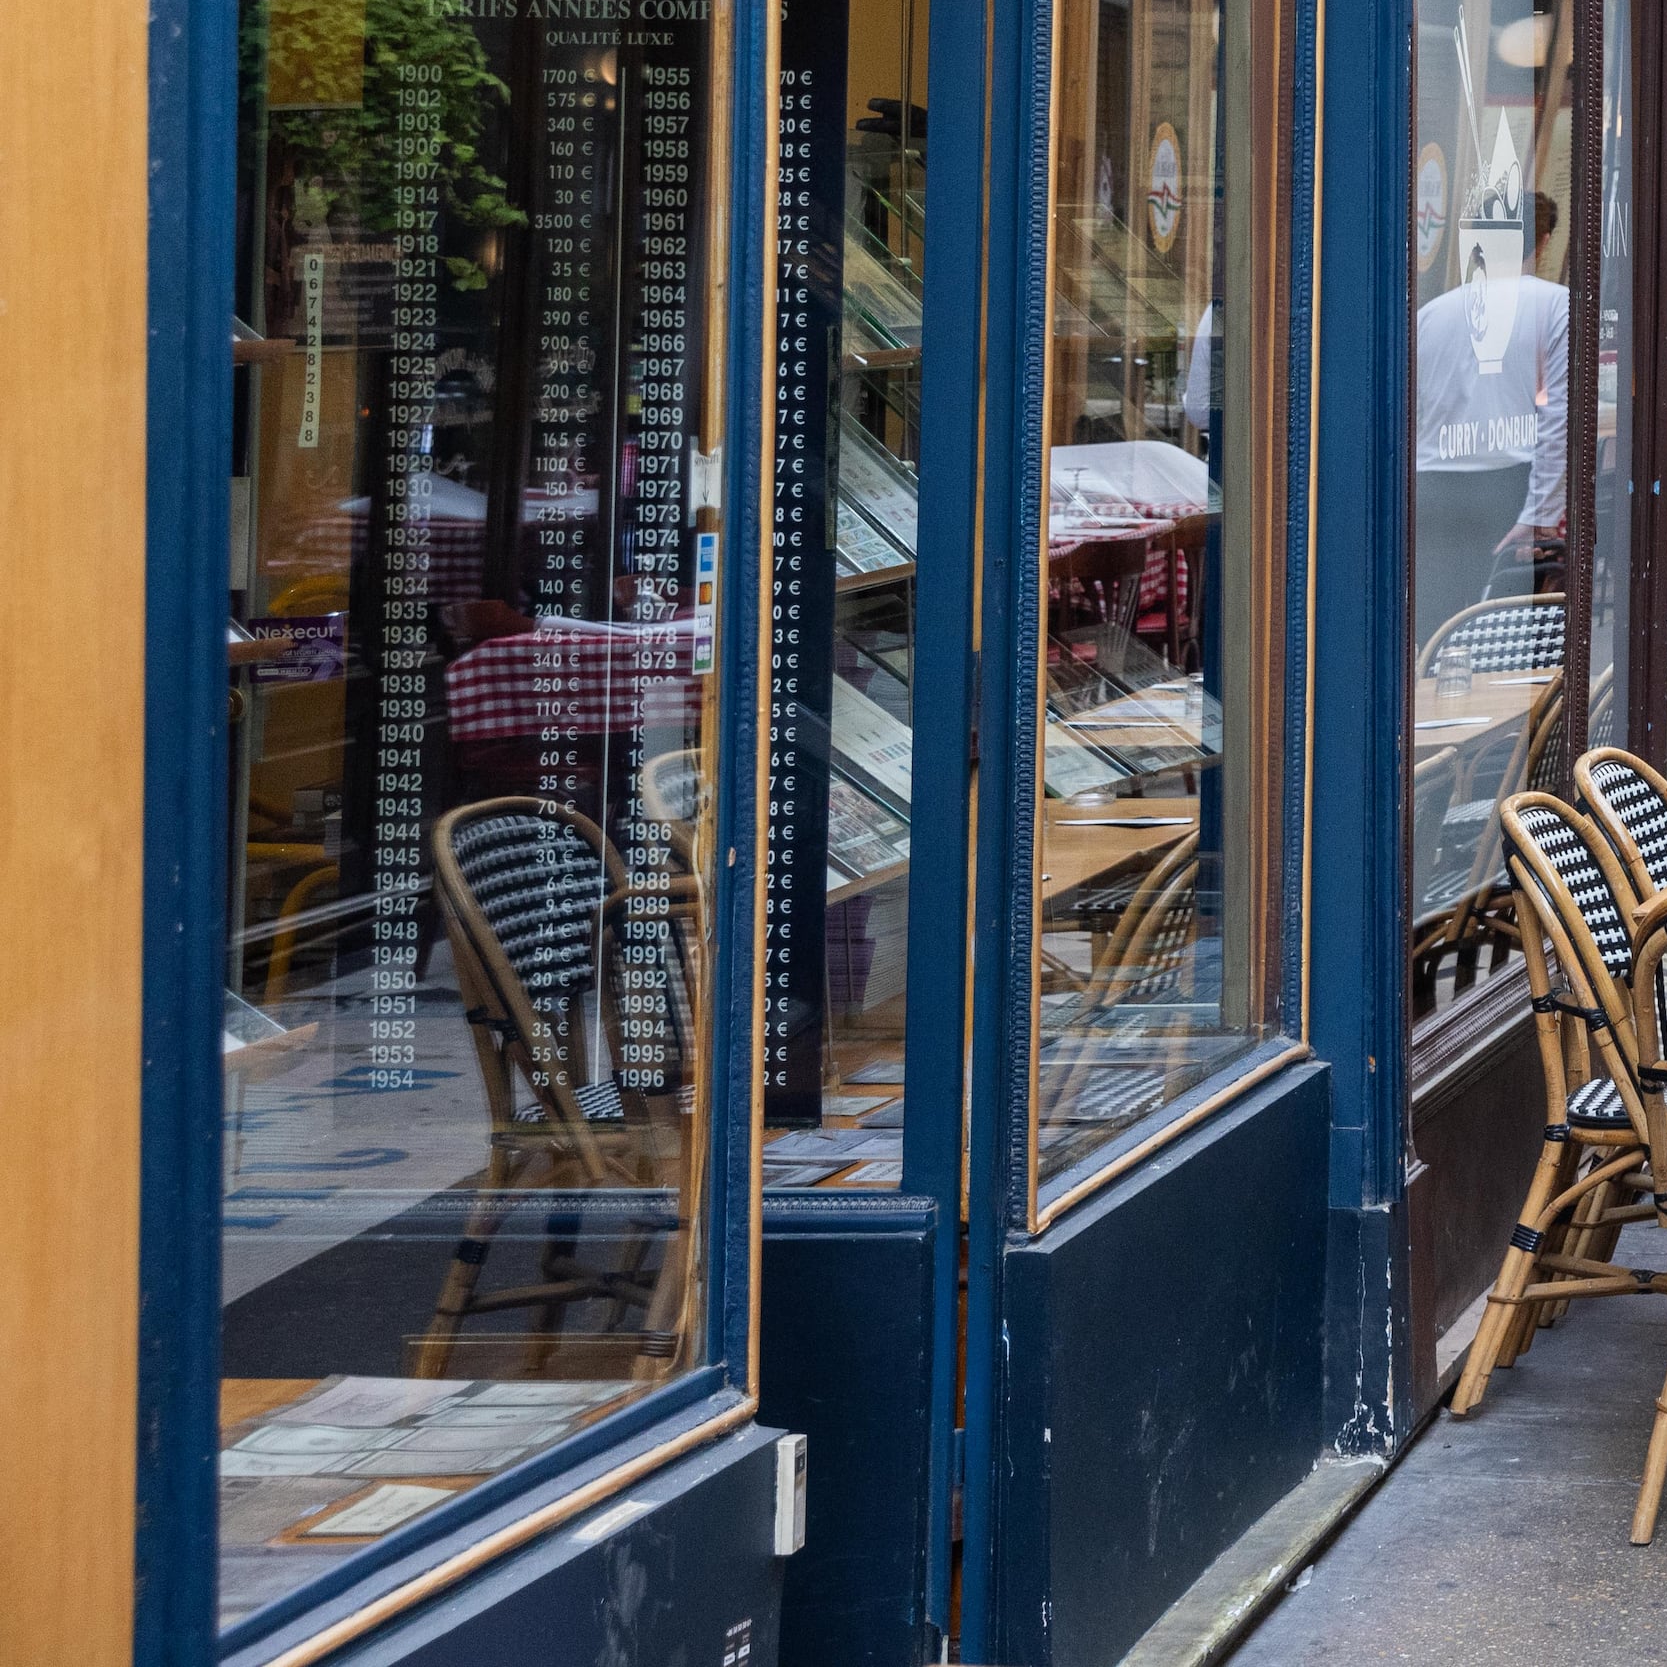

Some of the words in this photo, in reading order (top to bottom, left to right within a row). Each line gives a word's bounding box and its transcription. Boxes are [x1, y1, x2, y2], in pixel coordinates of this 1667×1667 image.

[545, 28, 623, 47] QUALITÉ
[628, 31, 674, 48] LUXE
[399, 65, 442, 83] 1900
[542, 69, 577, 85] 1700
[648, 68, 691, 86] 1955
[394, 210, 438, 228] 1917
[535, 214, 573, 229] 3500
[642, 213, 685, 231] 1961
[392, 284, 437, 302] 1922
[546, 287, 572, 302] 180
[640, 285, 686, 304] 1964
[1439, 420, 1479, 460] CURRY
[1488, 413, 1539, 452] DONBURI
[255, 624, 338, 640] Nexecur
[380, 626, 428, 644] 1936
[630, 651, 678, 670] 1979
[377, 774, 422, 791] 1942
[539, 775, 558, 790] 35
[368, 1071, 415, 1088] 1954
[532, 1072, 552, 1087] 95
[619, 1069, 665, 1088] 1996
